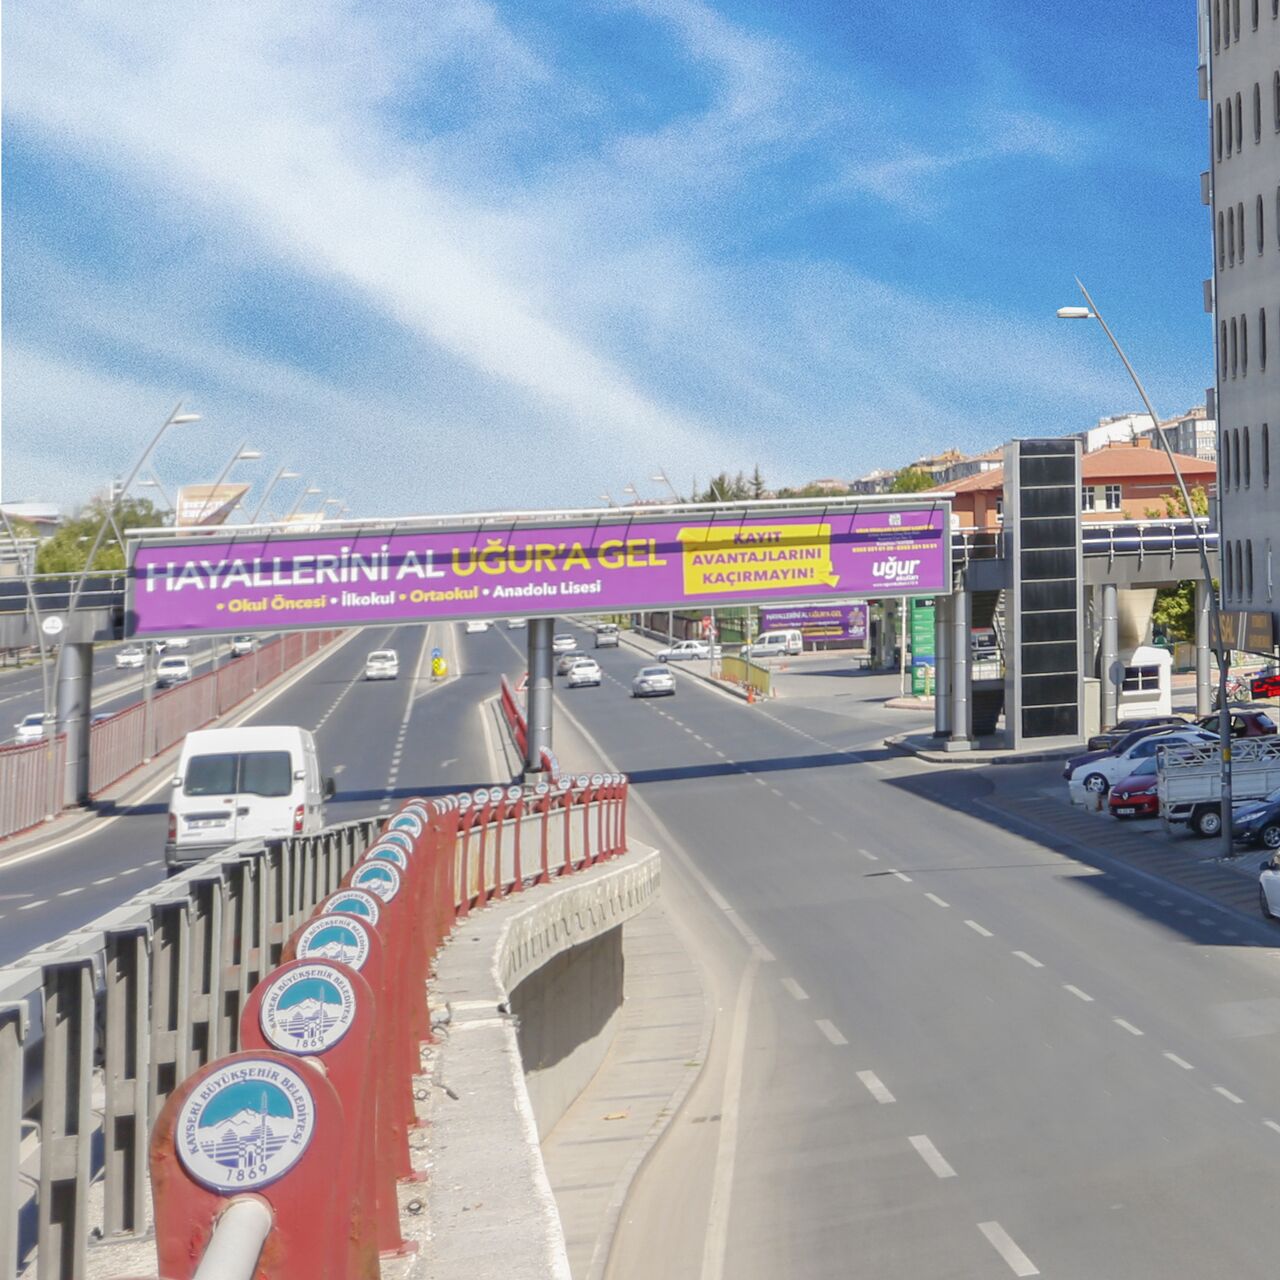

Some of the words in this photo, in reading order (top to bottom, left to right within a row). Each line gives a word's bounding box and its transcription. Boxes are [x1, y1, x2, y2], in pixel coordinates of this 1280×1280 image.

[733, 531, 782, 545] KAYIT
[146, 544, 390, 592] HAYALLERİNİ
[396, 549, 445, 580] AL
[451, 538, 592, 577] UĞUR'A
[597, 538, 667, 569] GEL
[692, 548, 822, 566] AVANTAJLARINI
[703, 567, 815, 586] KAÇIRMAYIN!
[872, 556, 921, 580] uğur
[228, 596, 268, 613] Okul
[271, 593, 327, 611] Öncesi
[341, 590, 396, 607] İlkokul
[410, 586, 479, 603] Ortaokul
[493, 582, 557, 598] Anadolu
[560, 579, 602, 595] Lisesi
[296, 1036, 324, 1048] 1869
[185, 1102, 203, 1155] KAYSERİ
[200, 1067, 281, 1102] BÜYÜKŞEHİR
[280, 1077, 308, 1145] BELEDİYESİ
[226, 1163, 268, 1182] 1869
